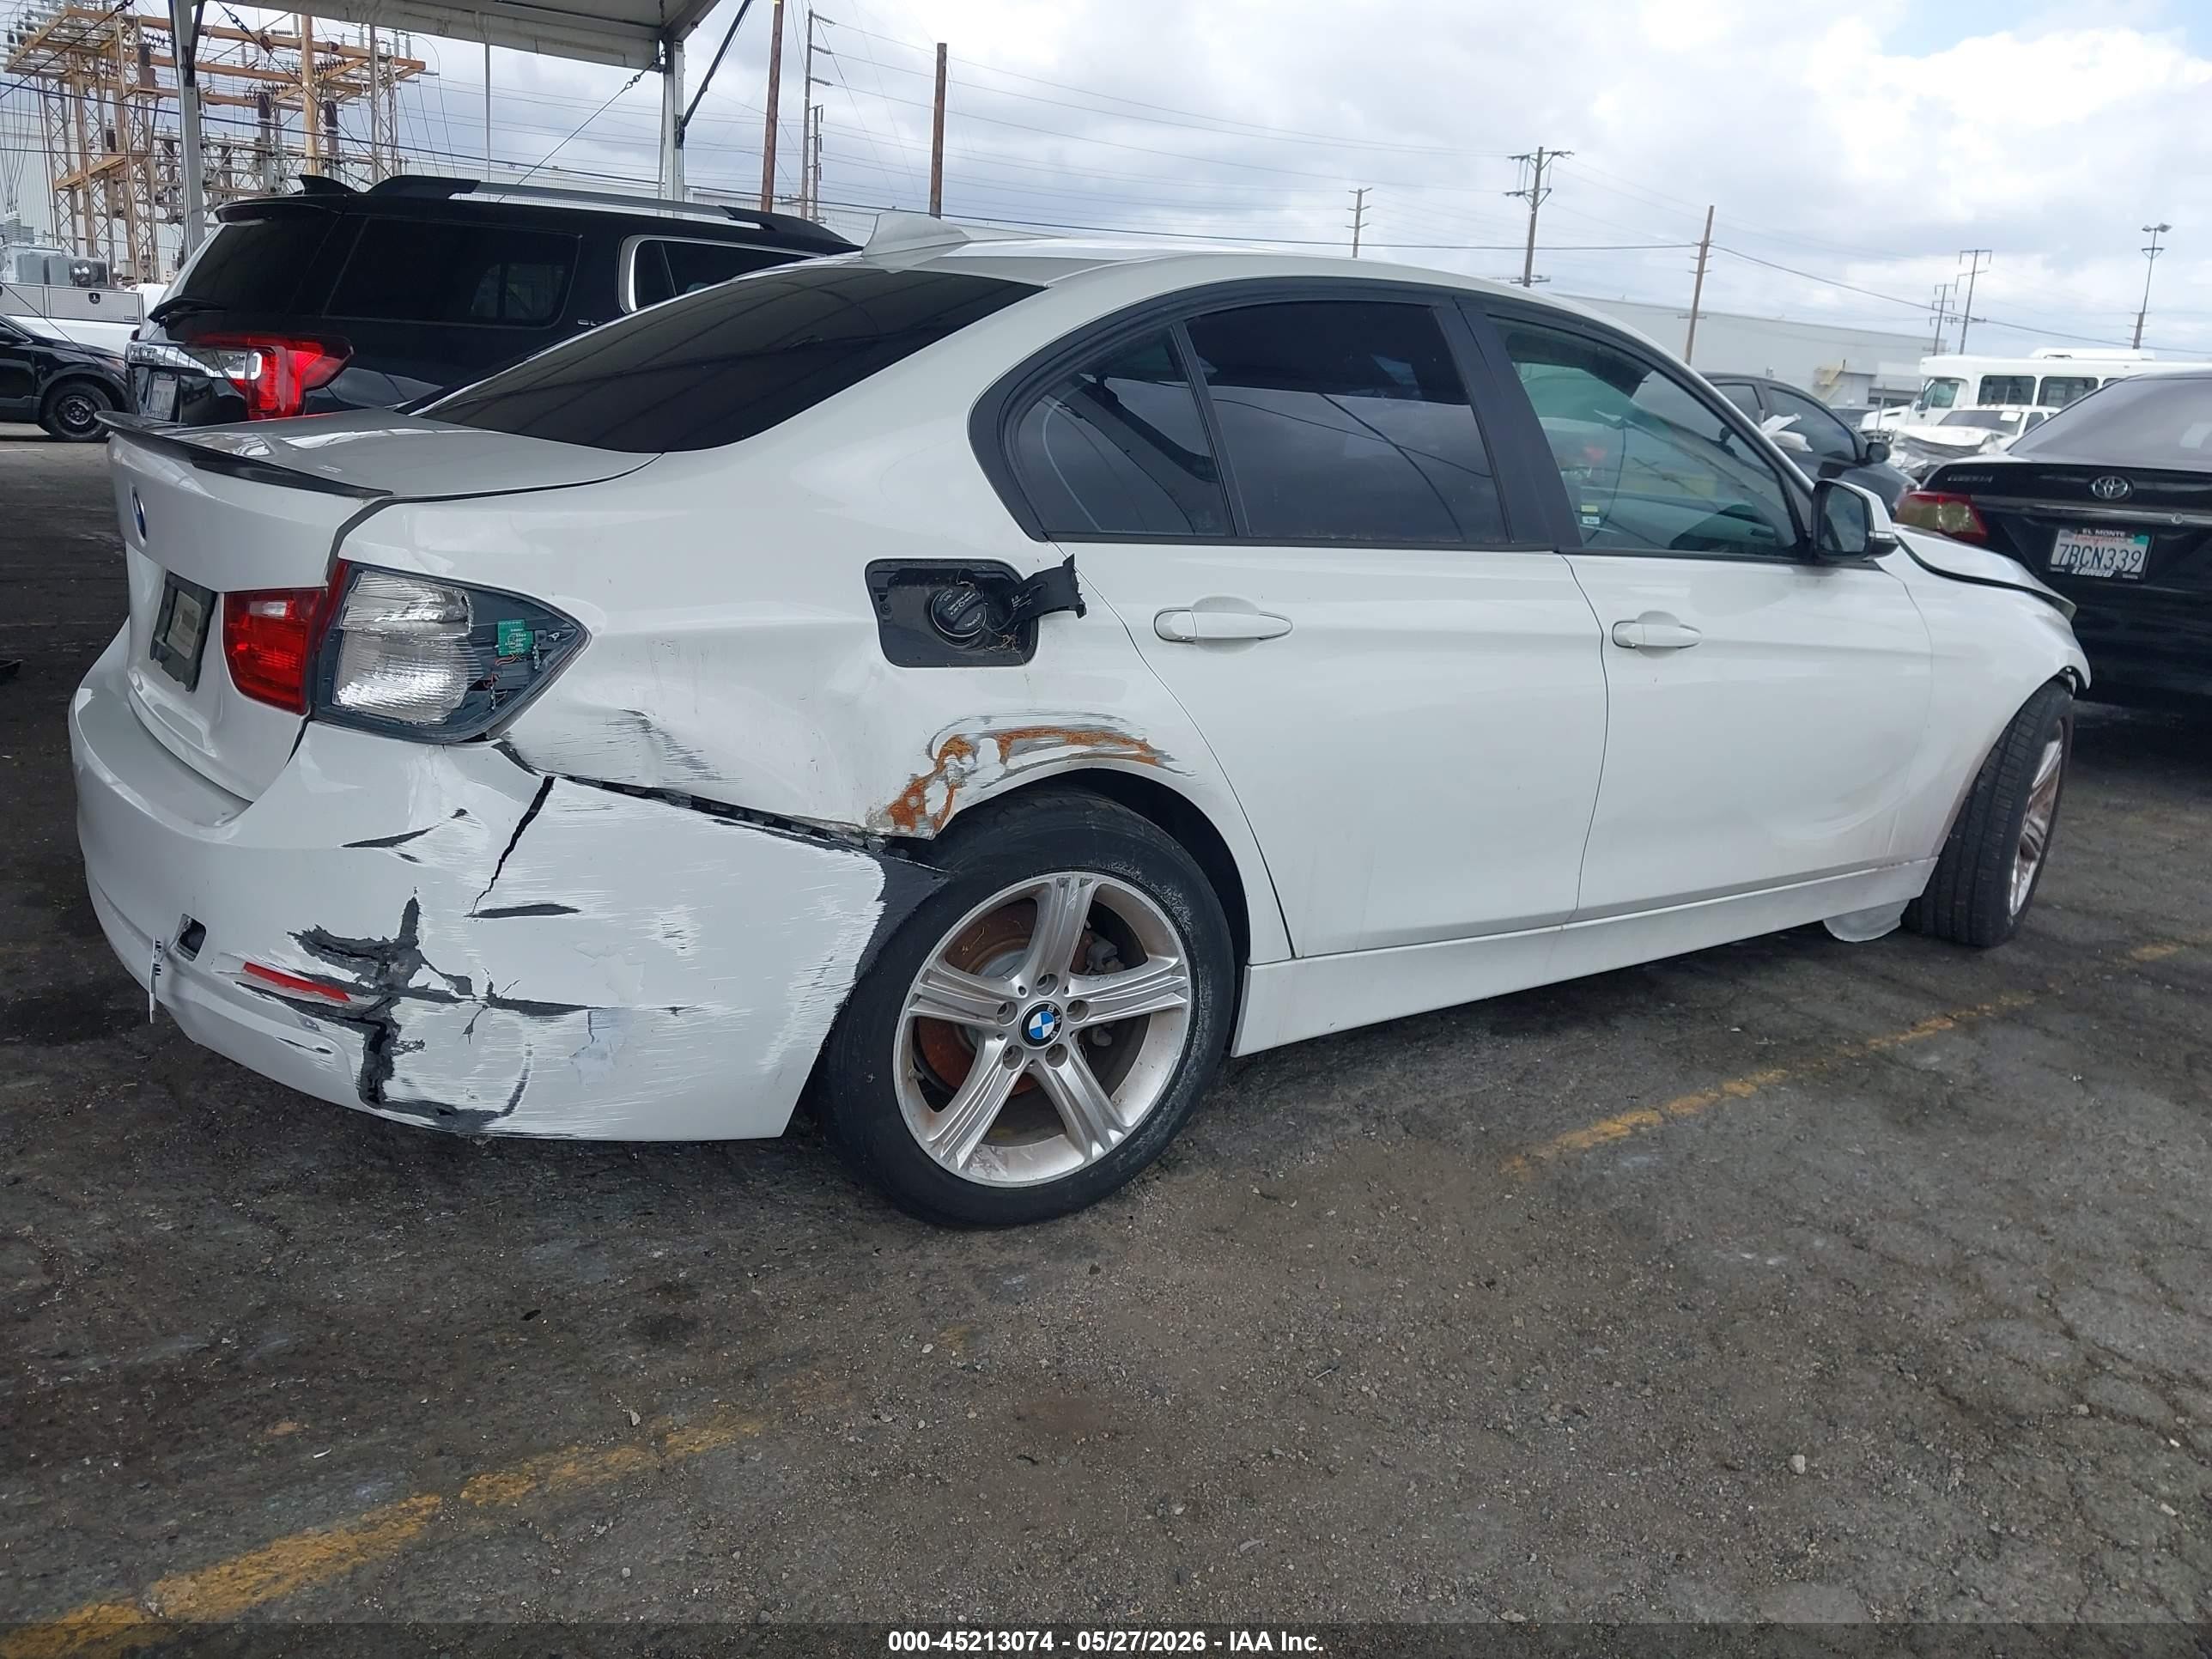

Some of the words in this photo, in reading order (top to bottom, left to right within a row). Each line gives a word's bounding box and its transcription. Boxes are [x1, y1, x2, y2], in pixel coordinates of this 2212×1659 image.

[2082, 527, 2094, 536] EL
[2095, 529, 2126, 538] MONTE
[2058, 544, 2142, 574] 7BCN339
[1048, 1005, 1061, 1039] BMW
